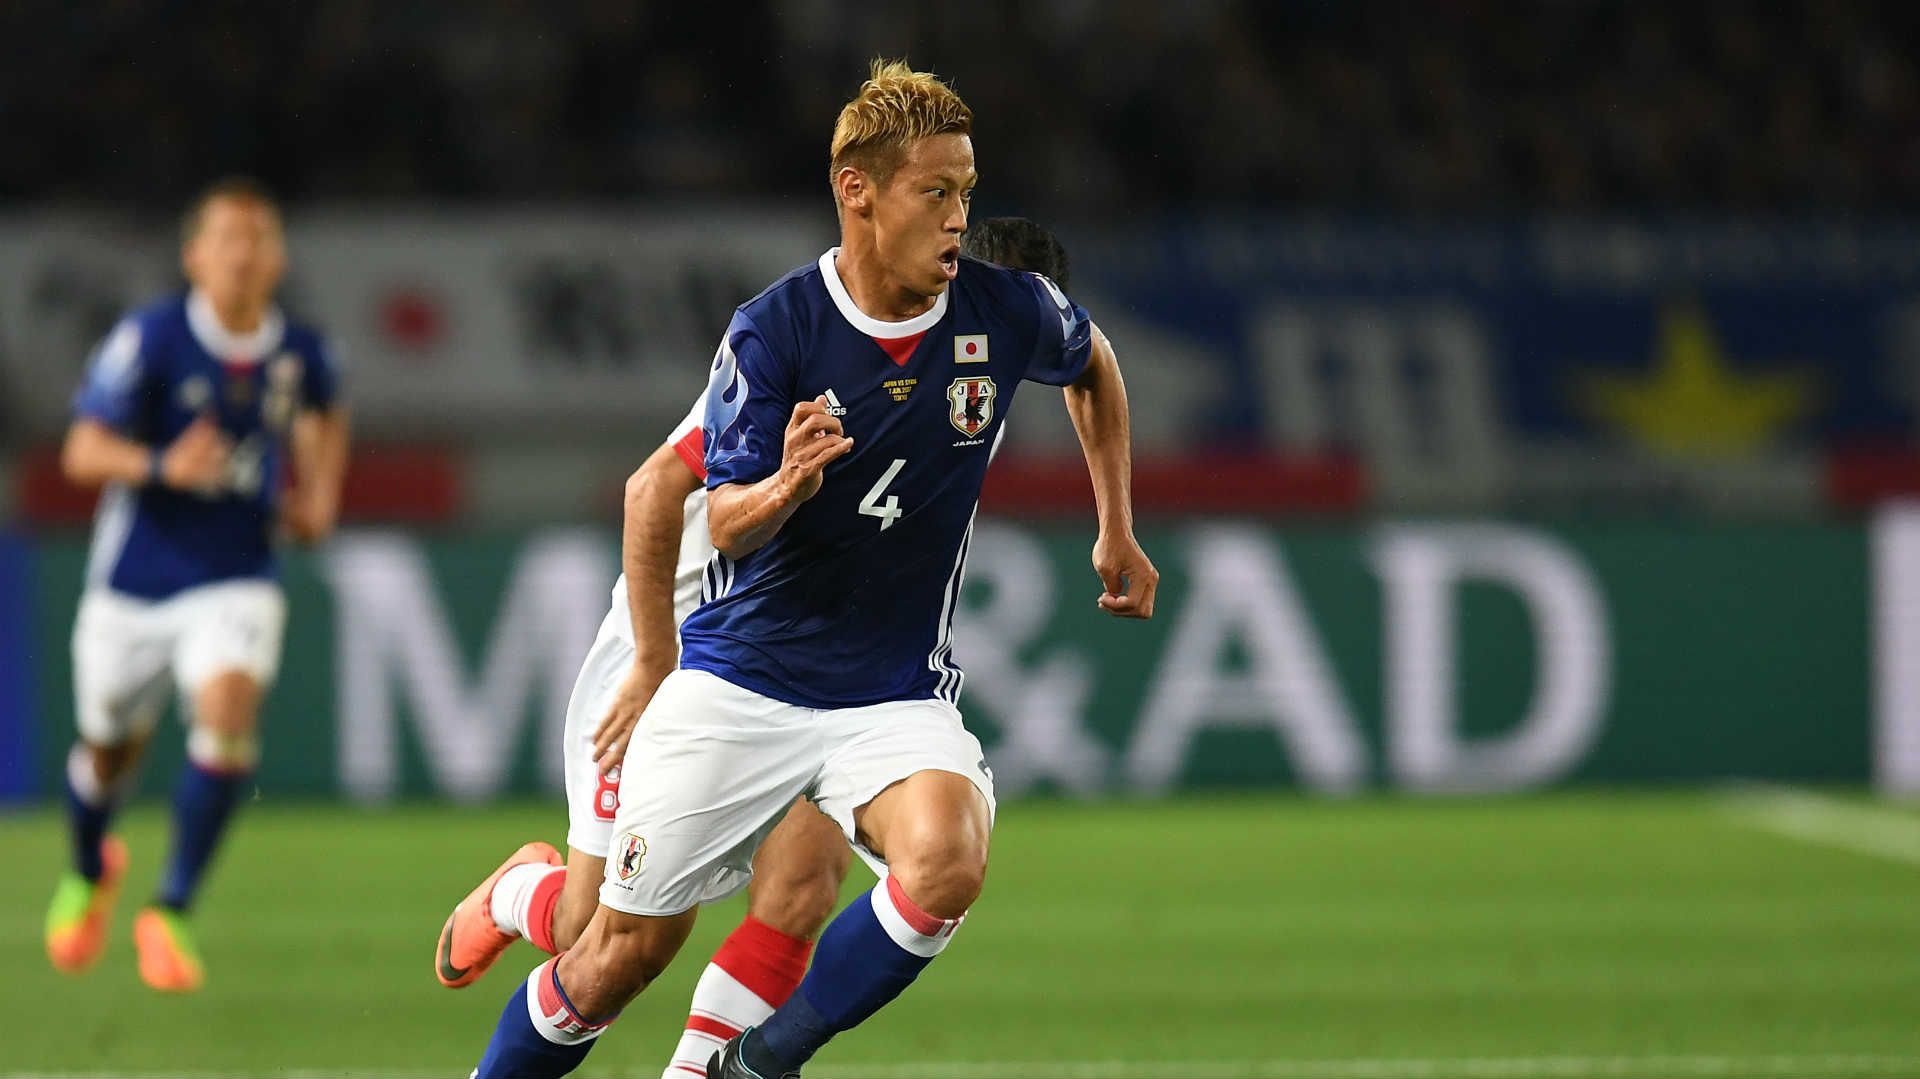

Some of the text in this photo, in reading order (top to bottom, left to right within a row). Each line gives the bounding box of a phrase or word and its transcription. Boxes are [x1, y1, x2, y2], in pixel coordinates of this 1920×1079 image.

[957, 384, 988, 396] JFA
[952, 439, 985, 447] JAPAN
[858, 459, 907, 532] 4
